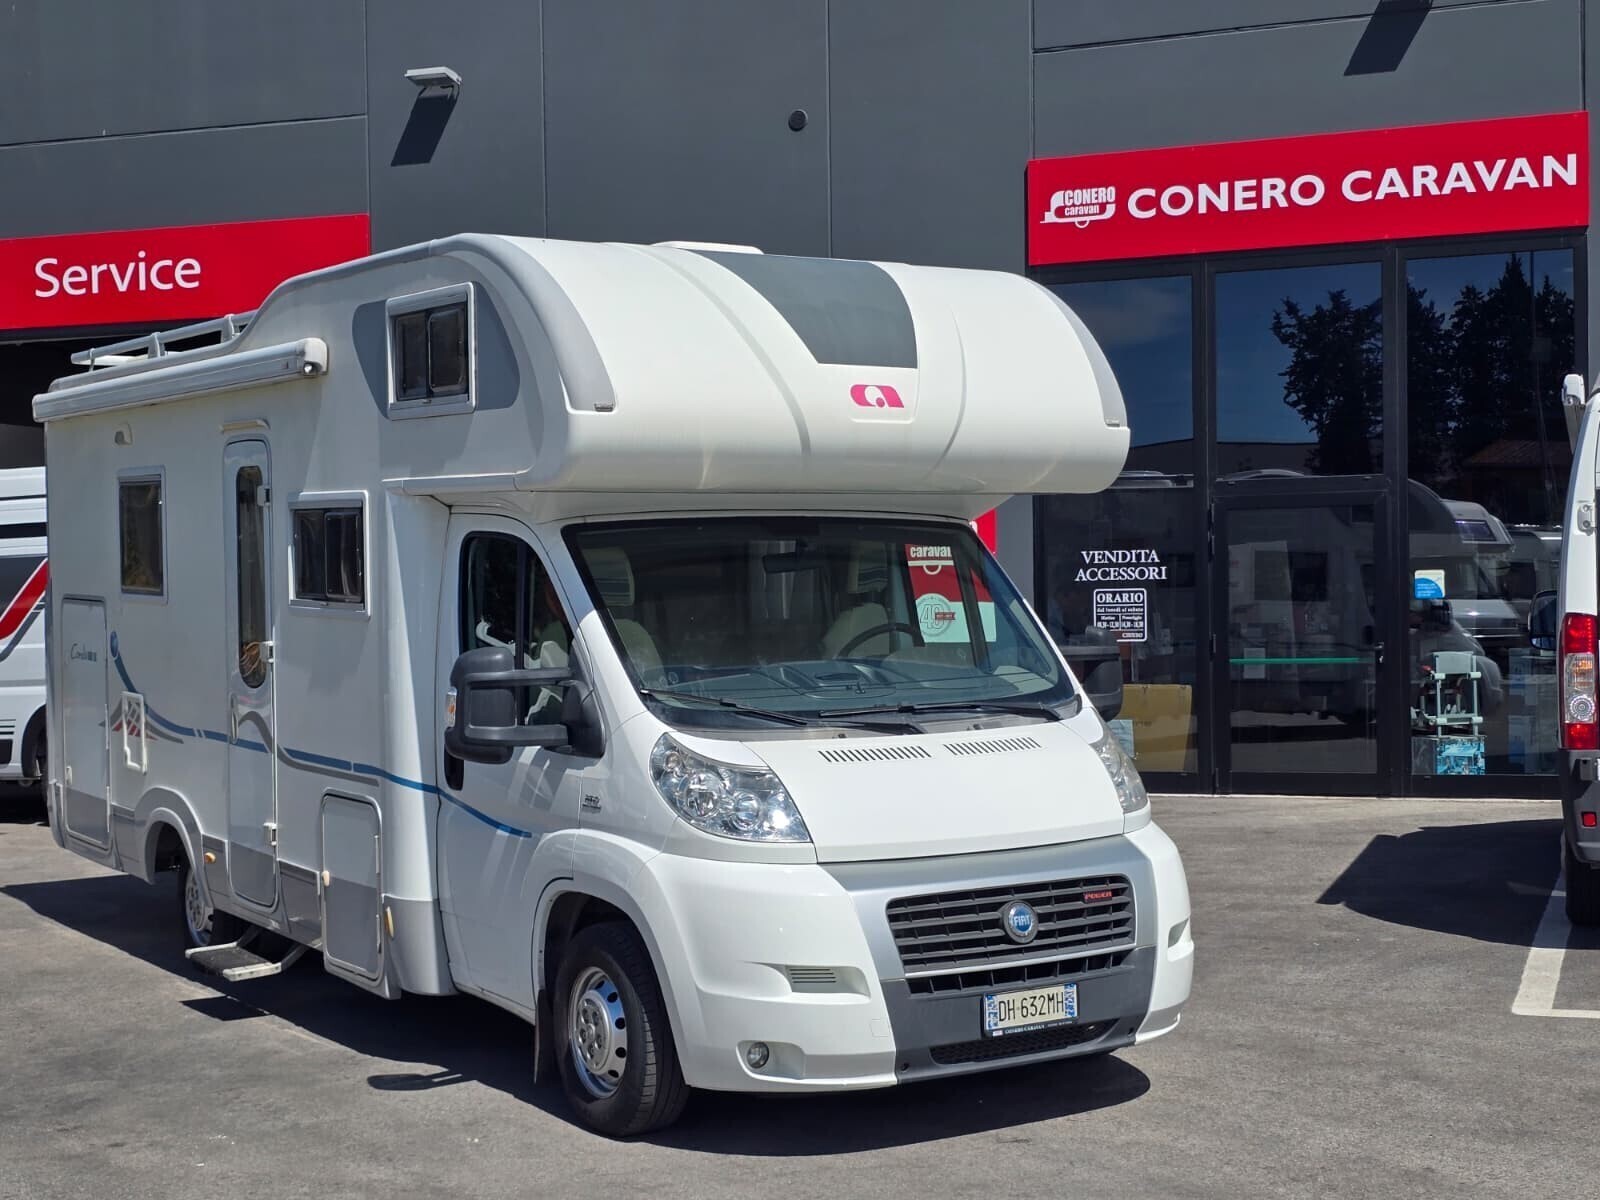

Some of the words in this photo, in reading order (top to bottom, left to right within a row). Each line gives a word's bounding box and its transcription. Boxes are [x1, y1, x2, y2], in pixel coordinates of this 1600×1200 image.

[1128, 174, 1325, 219] CONERO
[1341, 153, 1577, 202] CARAVAN
[1064, 186, 1116, 206] CONERO
[1064, 205, 1100, 216] caravan
[34, 251, 201, 298] Service
[1081, 549, 1160, 564] VENDITA
[1074, 566, 1168, 581] ACCESSORI
[1096, 592, 1144, 604] ORARIO
[1013, 915, 1031, 926] FIAT
[998, 999, 1016, 1022] DH
[1020, 992, 1065, 1018] 632MH
